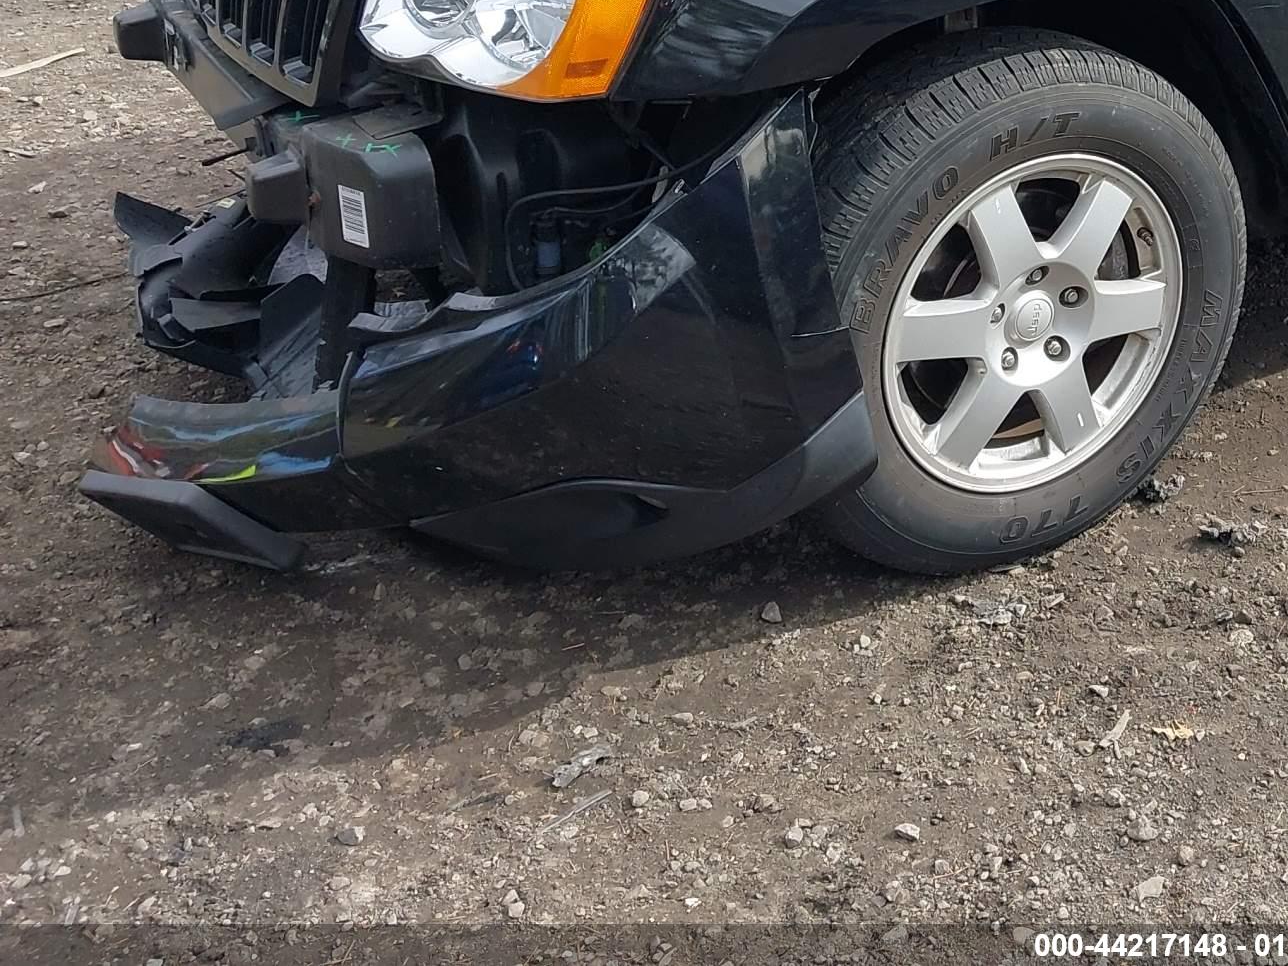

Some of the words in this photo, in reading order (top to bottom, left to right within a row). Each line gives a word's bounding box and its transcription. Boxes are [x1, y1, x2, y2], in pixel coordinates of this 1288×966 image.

[849, 166, 959, 334] BRAVO
[989, 111, 1081, 162] H/T
[1115, 289, 1224, 485] MAXXIS
[1000, 494, 1090, 544] 770
